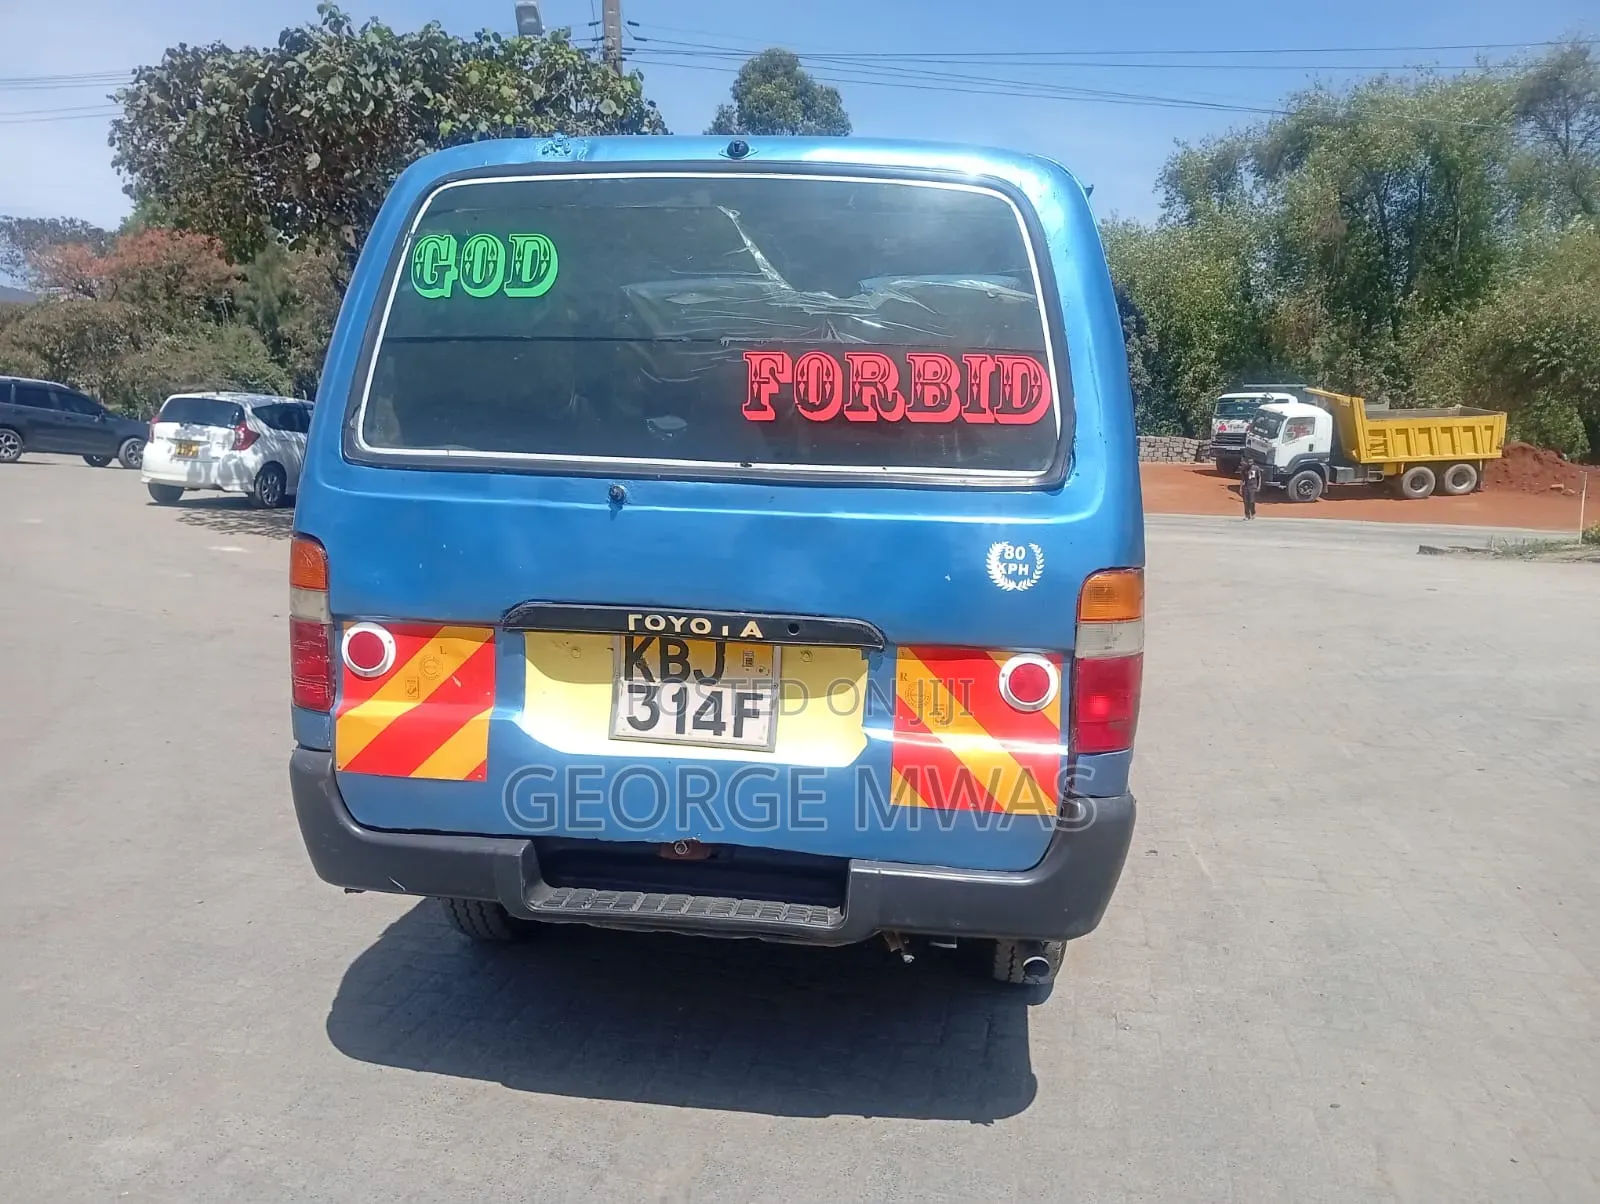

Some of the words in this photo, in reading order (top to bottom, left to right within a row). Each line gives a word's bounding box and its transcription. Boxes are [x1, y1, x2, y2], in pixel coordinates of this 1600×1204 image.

[411, 233, 559, 299] GOD
[742, 351, 1051, 424] FORBID
[998, 562, 1030, 576] KPH
[1004, 545, 1026, 560] 80
[624, 636, 726, 687] KBJ
[626, 686, 764, 739] 314F
